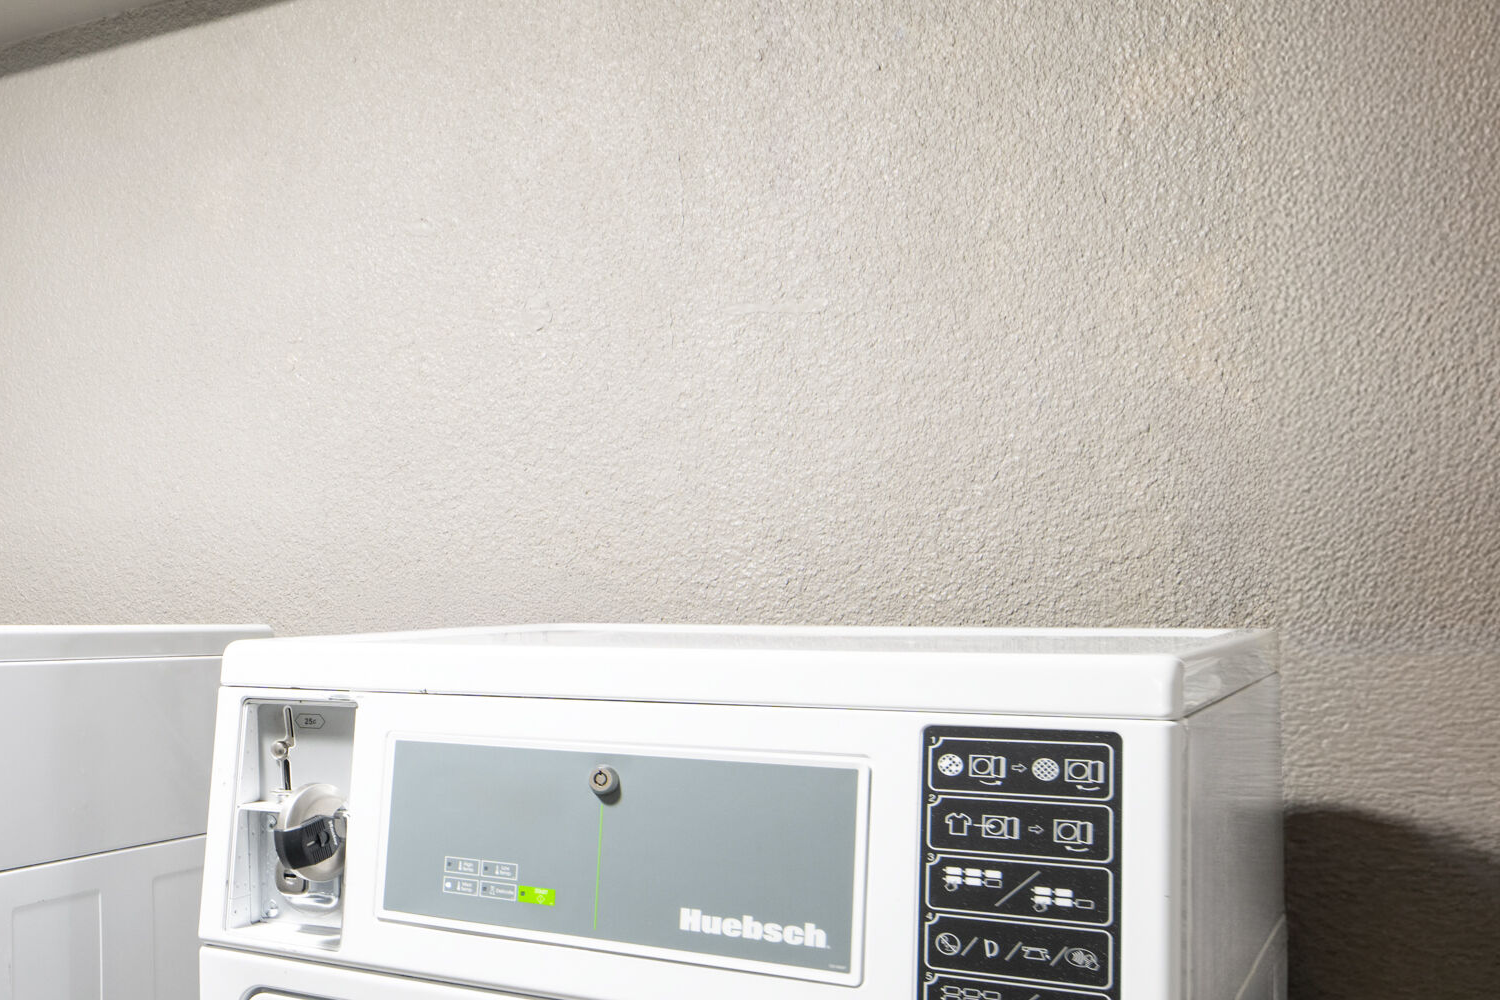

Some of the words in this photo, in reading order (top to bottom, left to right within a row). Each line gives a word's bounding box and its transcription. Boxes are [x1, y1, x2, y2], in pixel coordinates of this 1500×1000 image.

[930, 736, 936, 744] 1
[928, 794, 936, 802] 2
[927, 853, 935, 861] 3
[925, 912, 933, 920] 4
[679, 907, 827, 948] Huebsch
[925, 972, 933, 980] 5
